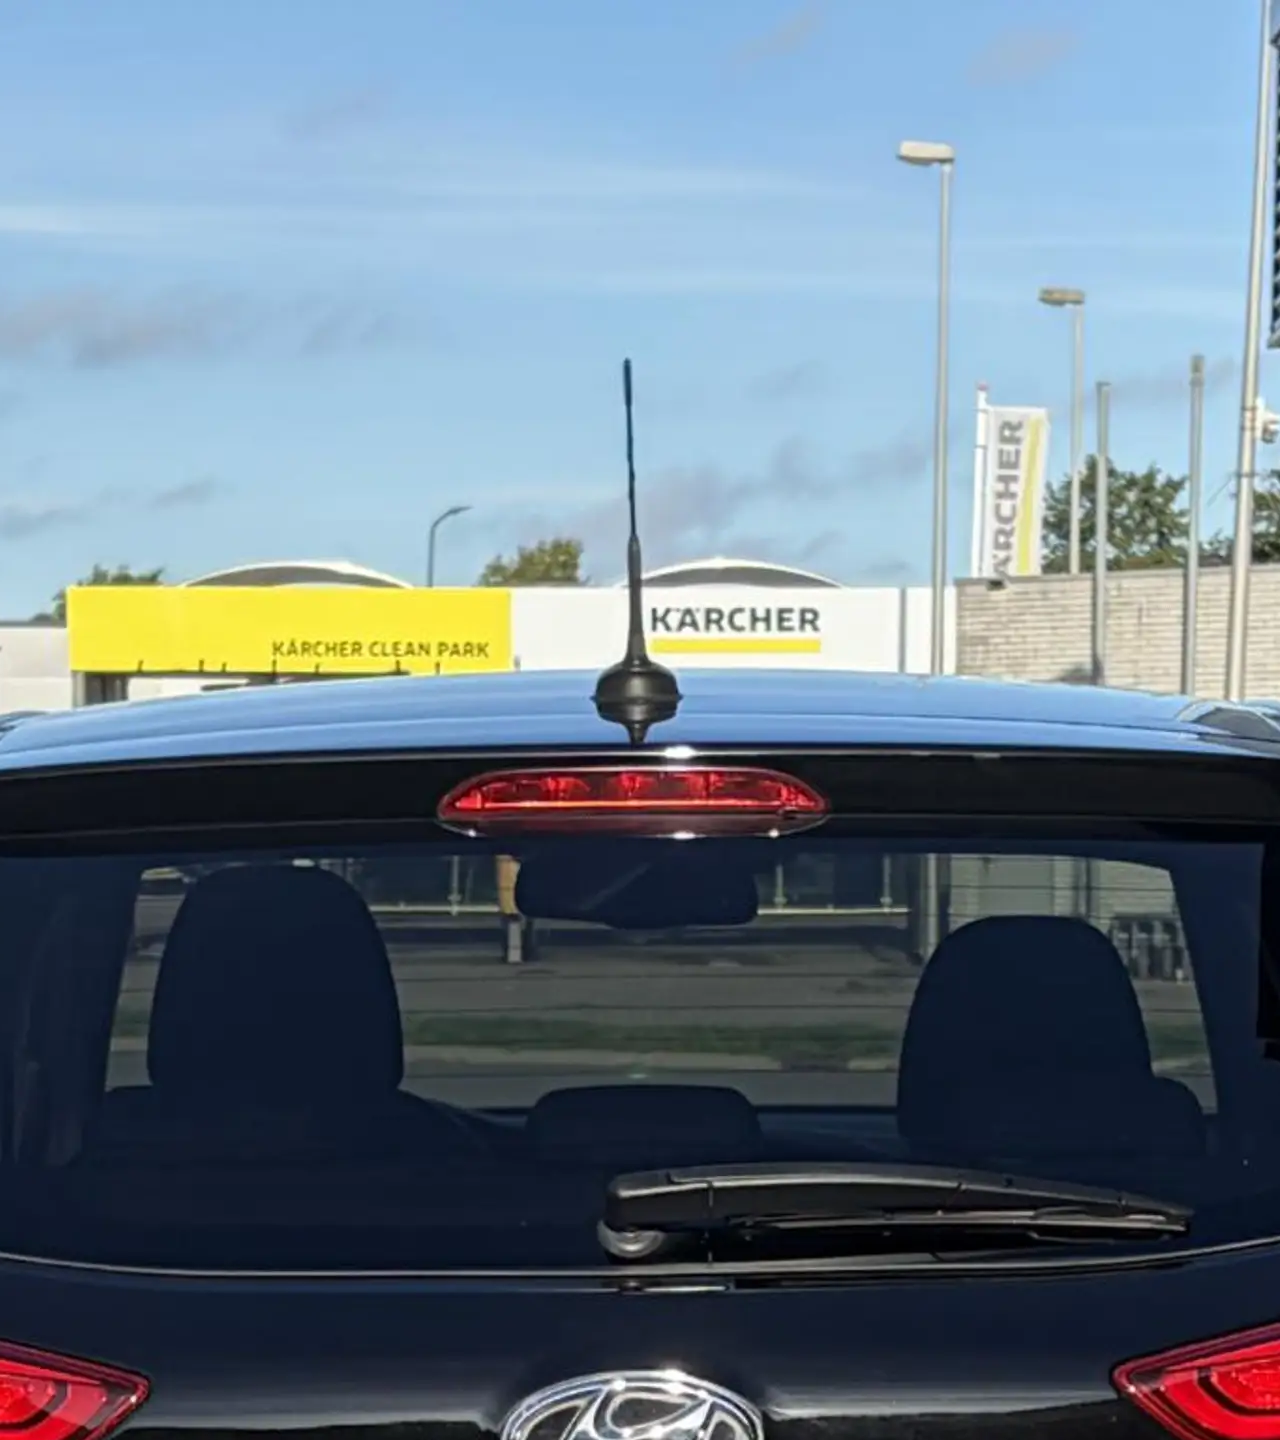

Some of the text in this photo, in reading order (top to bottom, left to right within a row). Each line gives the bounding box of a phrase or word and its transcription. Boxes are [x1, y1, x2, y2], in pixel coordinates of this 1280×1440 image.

[992, 420, 1023, 578] ÄRCHER
[651, 606, 821, 632] KÄRCHER
[369, 641, 431, 657] CLEAN
[437, 642, 489, 658] PARK
